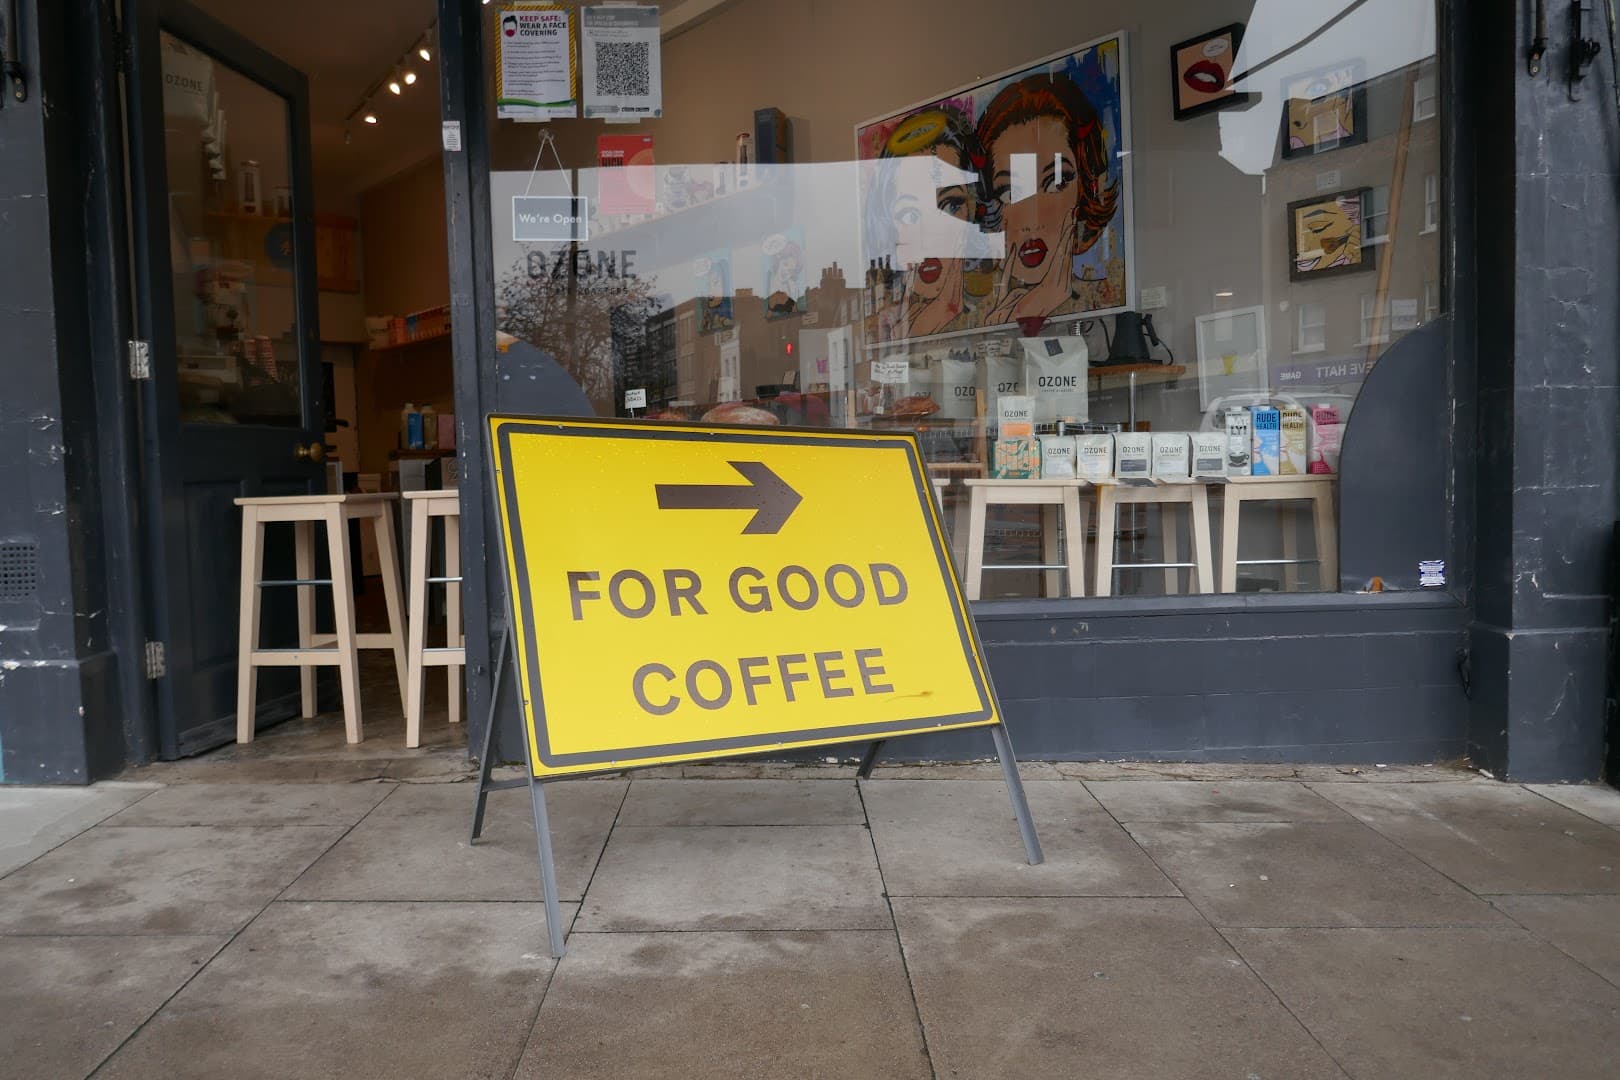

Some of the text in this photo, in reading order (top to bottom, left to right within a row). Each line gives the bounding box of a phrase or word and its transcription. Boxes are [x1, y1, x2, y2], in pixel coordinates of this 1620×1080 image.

[166, 74, 203, 91] OZONE
[519, 213, 582, 226] We're Open
[527, 249, 637, 279] OZONE
[1038, 375, 1077, 387] OZONE
[954, 386, 976, 397] OZO
[1004, 410, 1028, 418] OZONE
[1256, 412, 1277, 422] RUDE
[1256, 422, 1277, 431] HEALTH
[1048, 447, 1071, 455] OZONE
[1159, 446, 1183, 454] OZONE
[1200, 445, 1221, 453] OZONE
[566, 562, 909, 621] FOR GOOD
[632, 648, 894, 716] COFFEE
